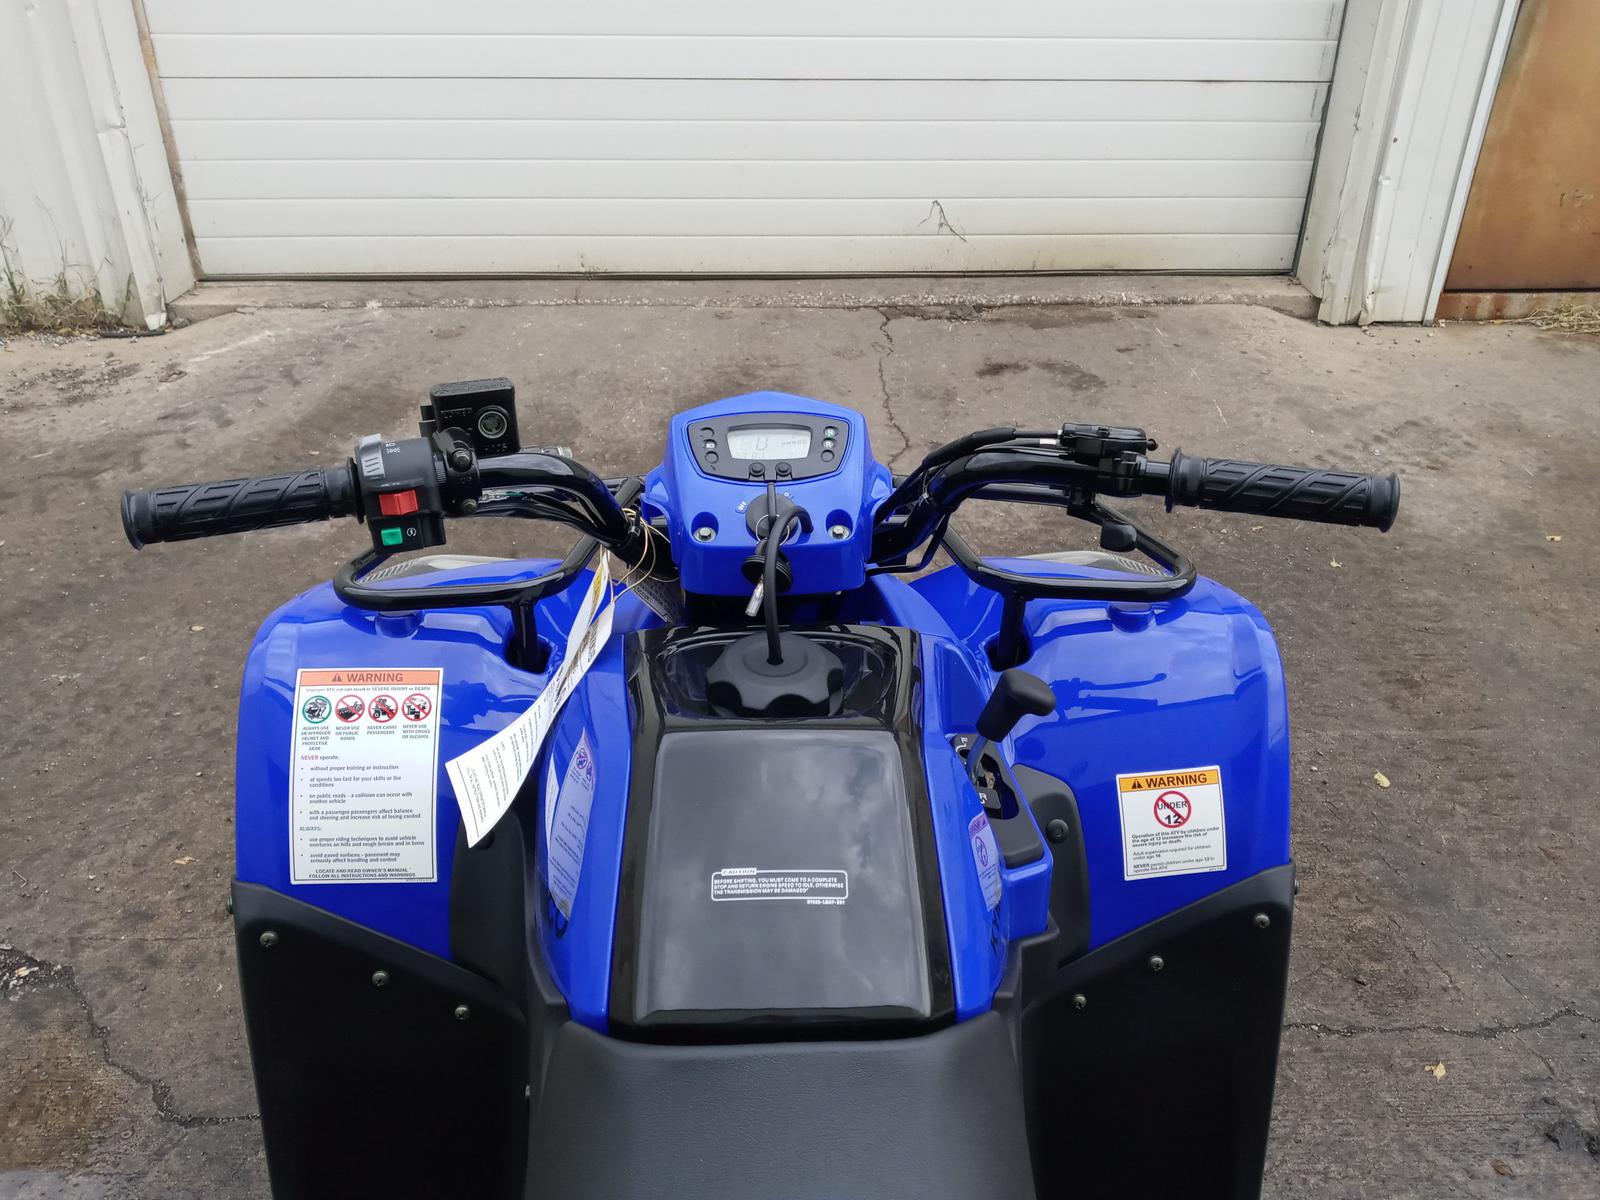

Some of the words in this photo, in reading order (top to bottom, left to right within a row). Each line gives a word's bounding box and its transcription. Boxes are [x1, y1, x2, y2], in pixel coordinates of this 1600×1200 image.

[347, 673, 403, 682] WARNING
[1146, 774, 1207, 788] WARNING
[1158, 801, 1188, 810] UNDER
[1165, 814, 1182, 824] 12
